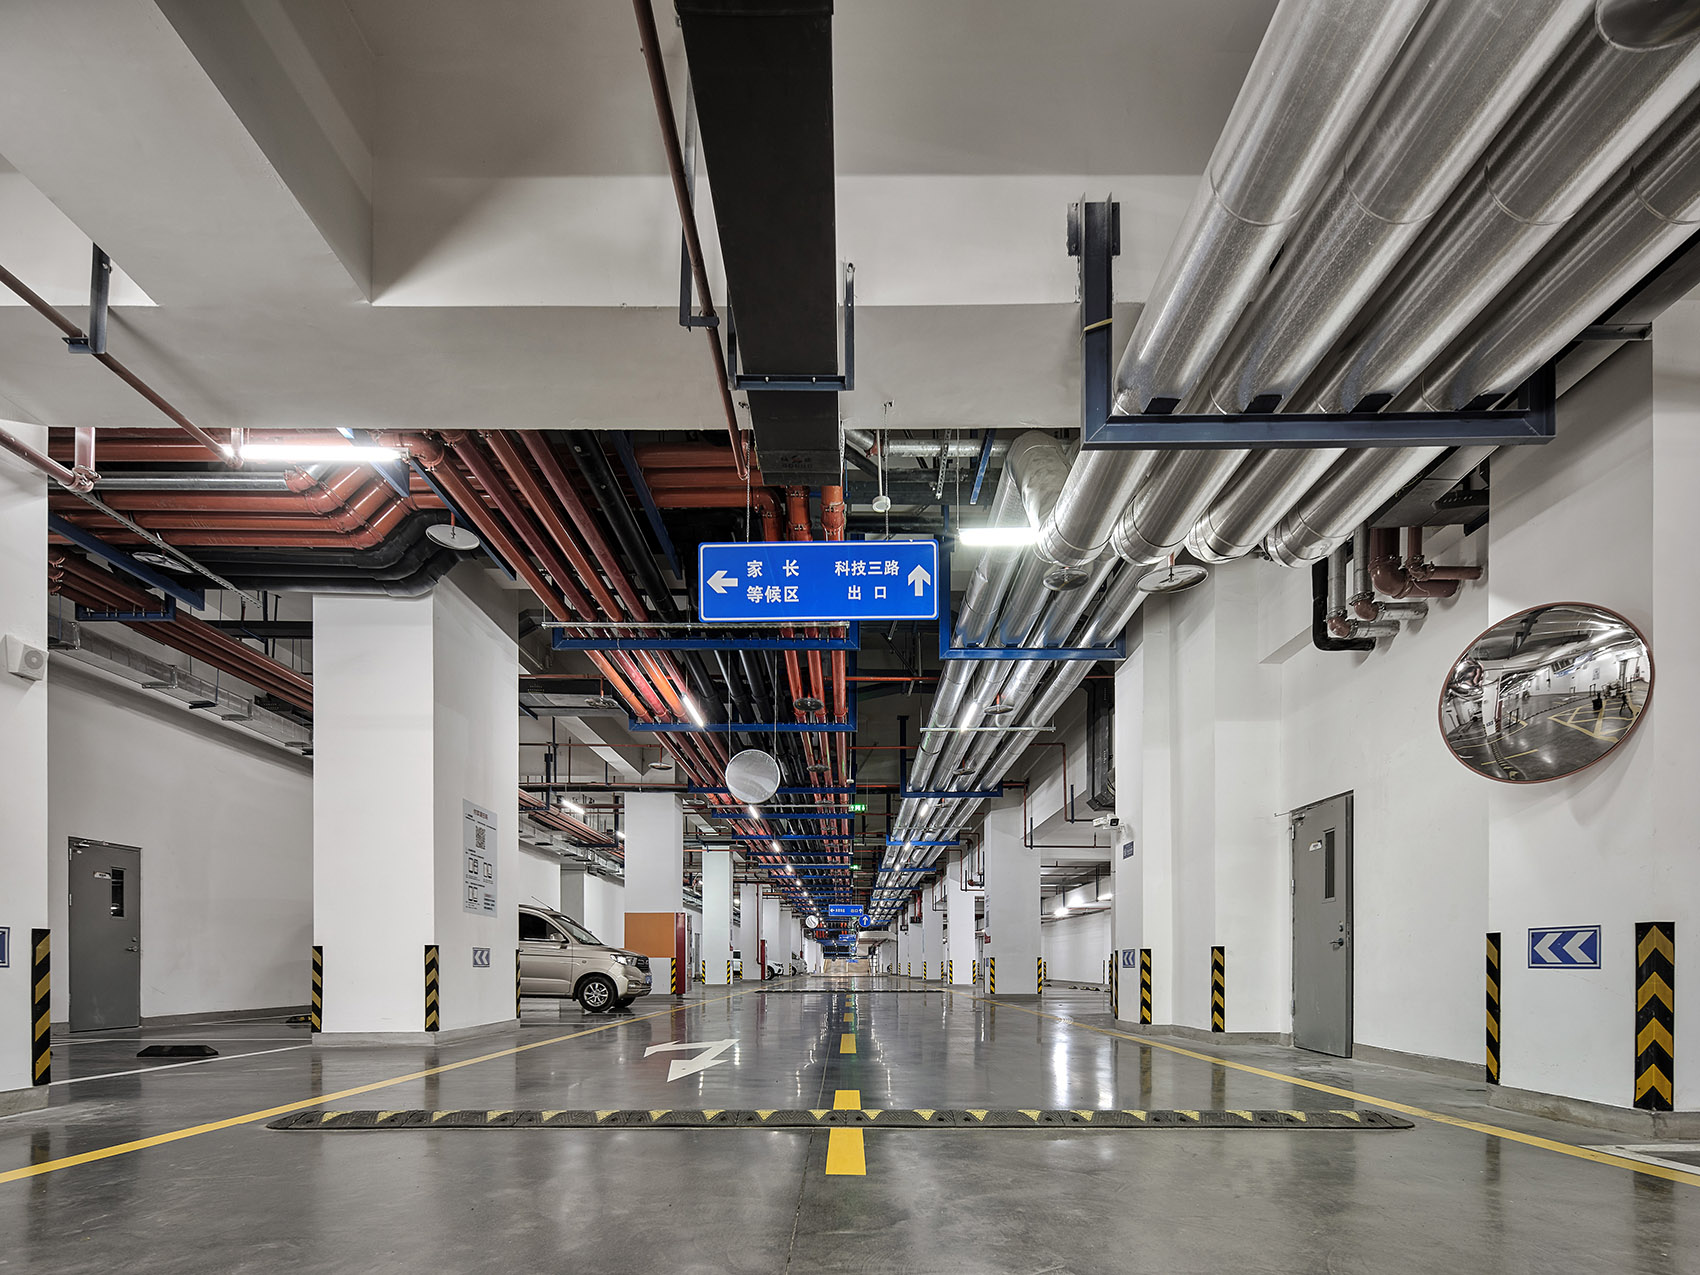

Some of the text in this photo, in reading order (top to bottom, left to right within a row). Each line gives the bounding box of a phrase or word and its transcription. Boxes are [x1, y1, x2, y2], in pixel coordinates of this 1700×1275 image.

[747, 559, 800, 578] 家长
[834, 559, 900, 577] 科技三路
[746, 585, 800, 604] 等候区
[848, 586, 888, 601] 出口
